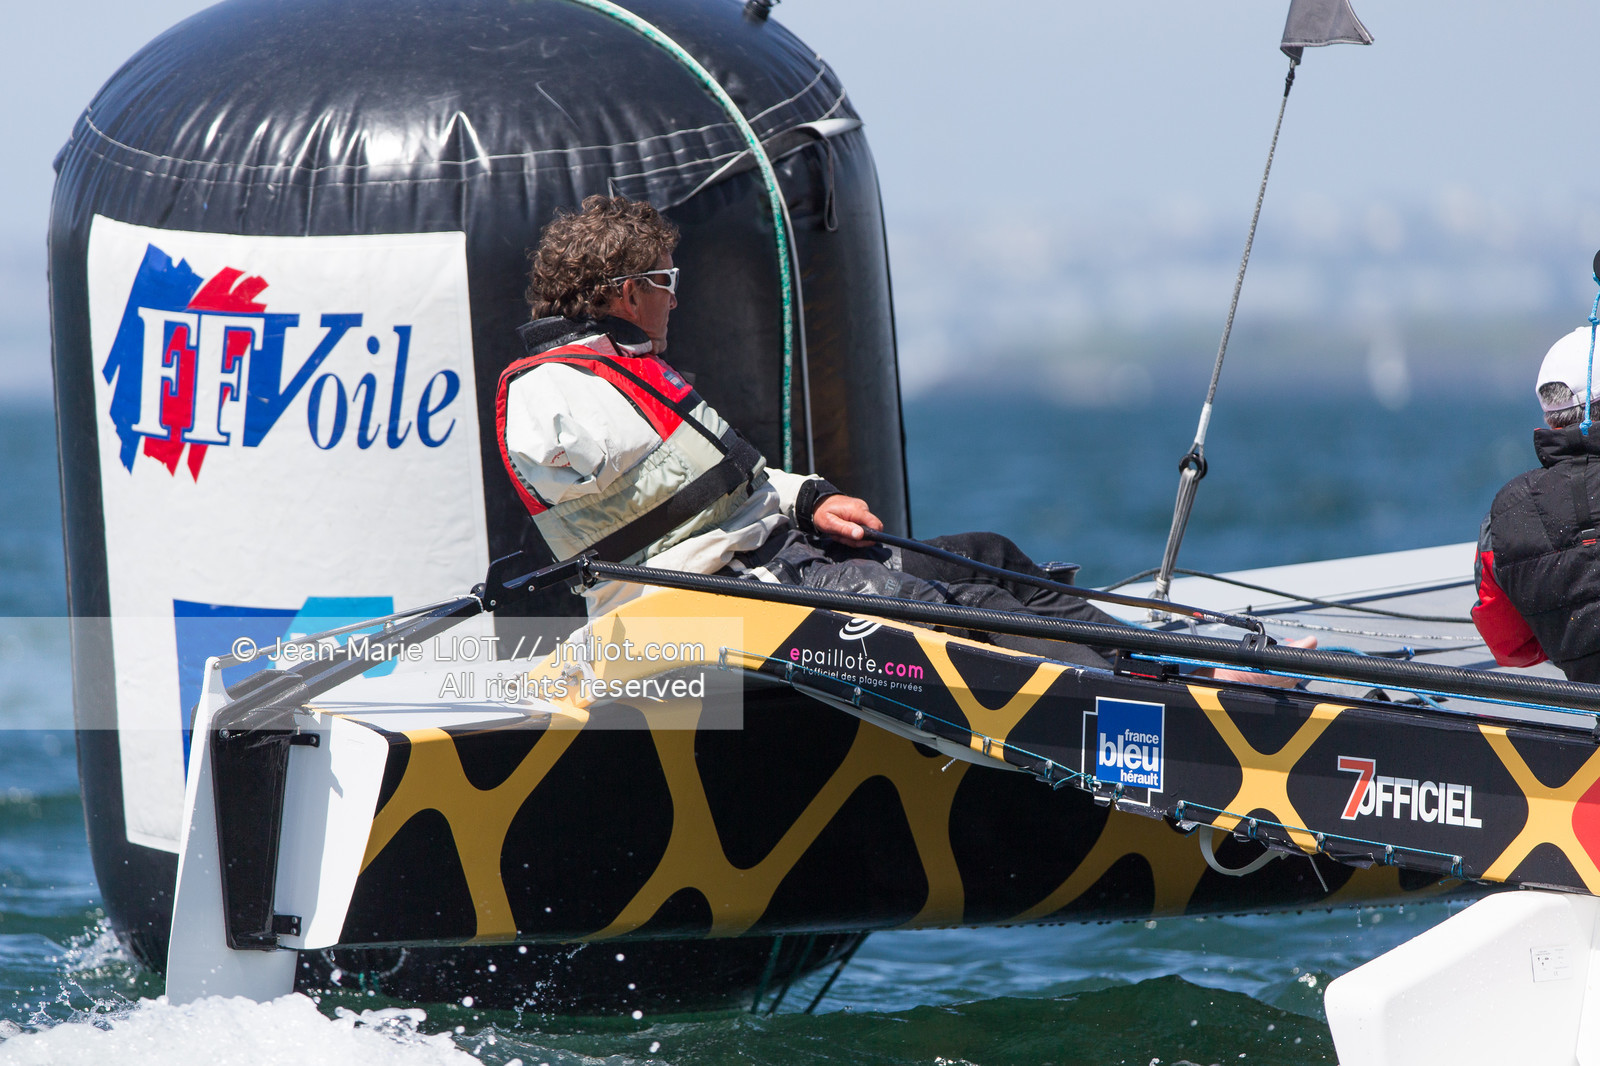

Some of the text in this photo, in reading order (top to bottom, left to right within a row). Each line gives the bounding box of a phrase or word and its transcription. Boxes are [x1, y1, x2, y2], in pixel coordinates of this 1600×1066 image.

[131, 306, 460, 450] FFVoile
[789, 647, 924, 680] epaillote.com
[841, 672, 856, 682] des
[859, 675, 888, 688] plages
[890, 680, 923, 693] privées
[1125, 728, 1159, 744] france
[1099, 732, 1159, 772] bleu
[1120, 769, 1159, 786] hérault
